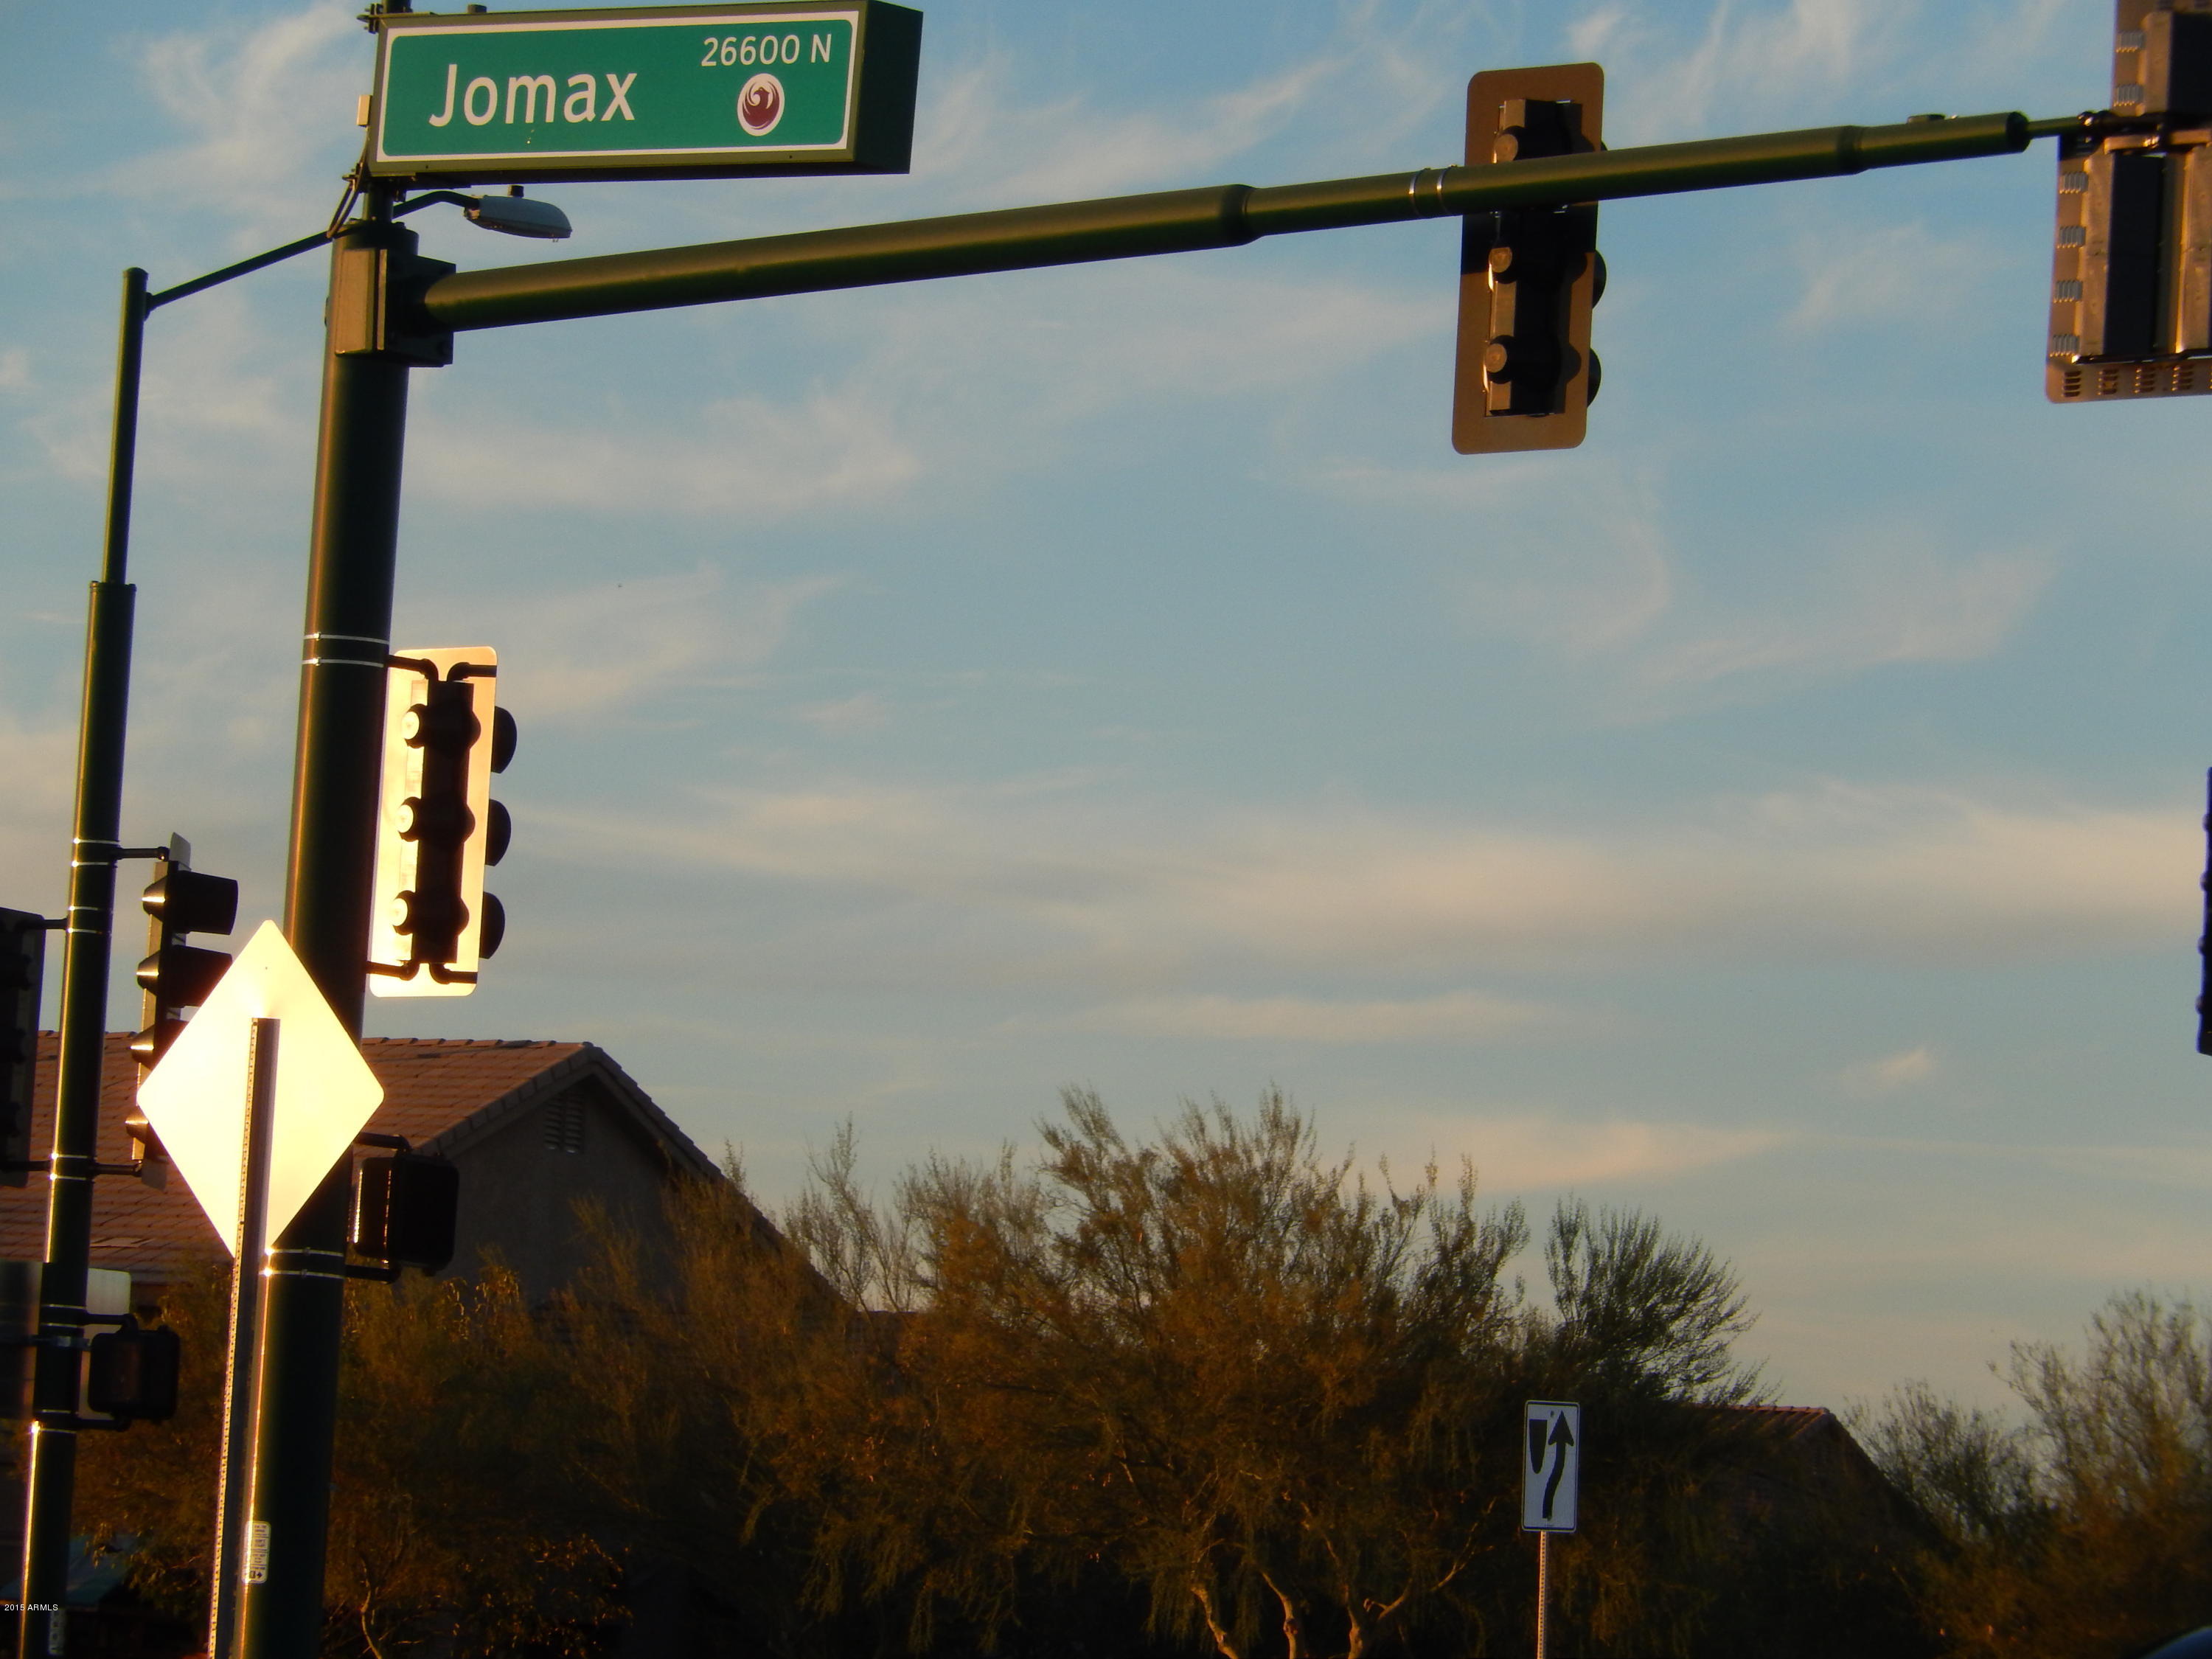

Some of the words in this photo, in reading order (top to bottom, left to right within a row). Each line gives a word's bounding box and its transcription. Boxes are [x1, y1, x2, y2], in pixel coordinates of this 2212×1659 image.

[700, 34, 800, 67] 26600
[810, 33, 832, 63] N
[429, 63, 637, 128] Jomax
